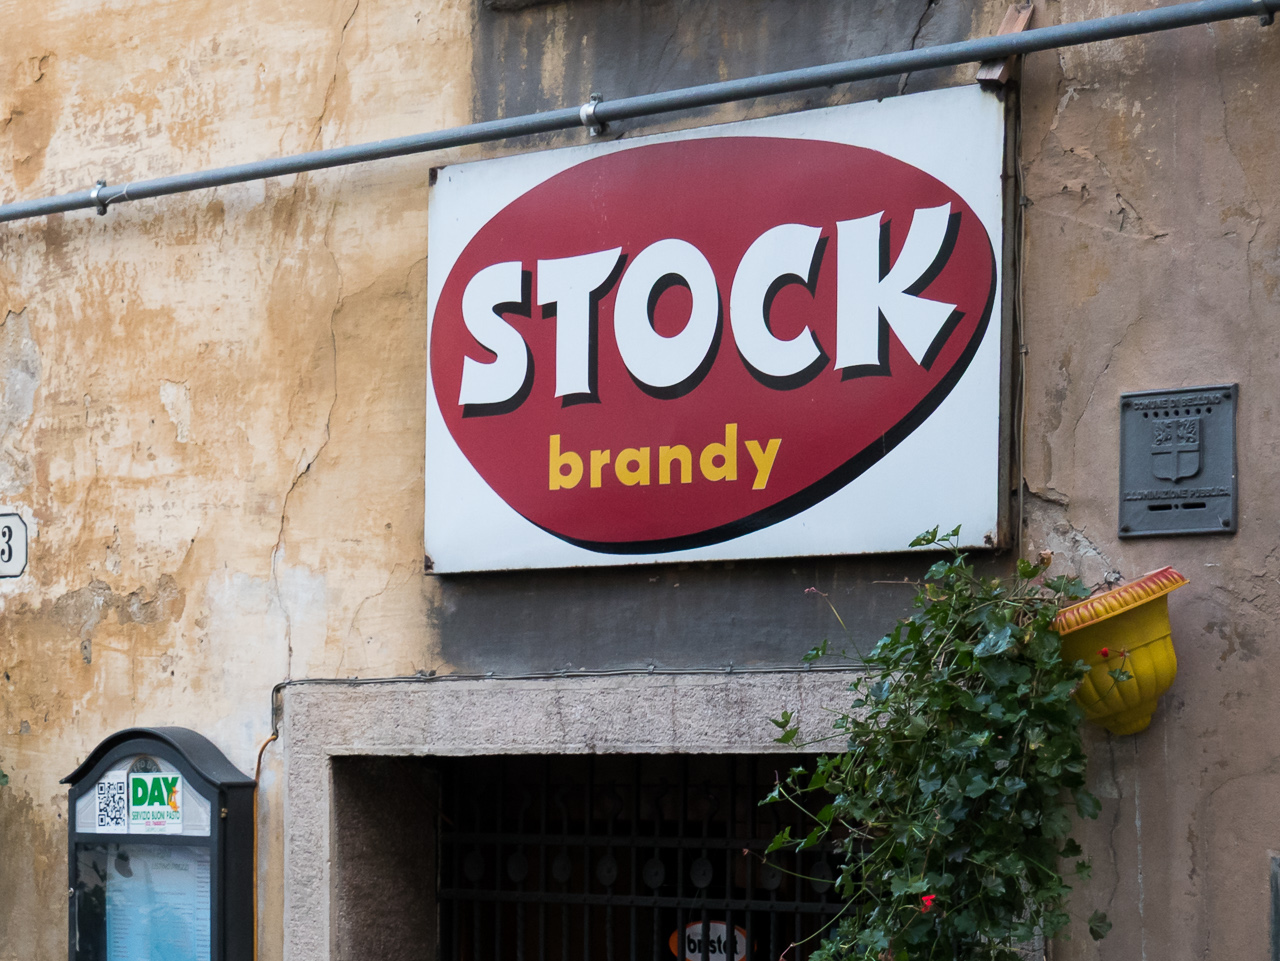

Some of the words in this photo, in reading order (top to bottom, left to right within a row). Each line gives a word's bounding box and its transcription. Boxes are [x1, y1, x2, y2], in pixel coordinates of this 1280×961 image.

[458, 202, 961, 410] STOCK
[1133, 399, 1168, 410] COMUNE
[1170, 396, 1180, 408] DI
[1182, 394, 1220, 406] BELLUNO
[549, 423, 782, 490] brandy
[1123, 488, 1188, 502] ILLUMINAZIONE
[1189, 486, 1231, 498] PUBBLICA
[132, 777, 179, 806] DAY
[132, 811, 150, 820] SERVIZIO
[151, 811, 165, 820] BUONI
[166, 811, 180, 820] PASTO
